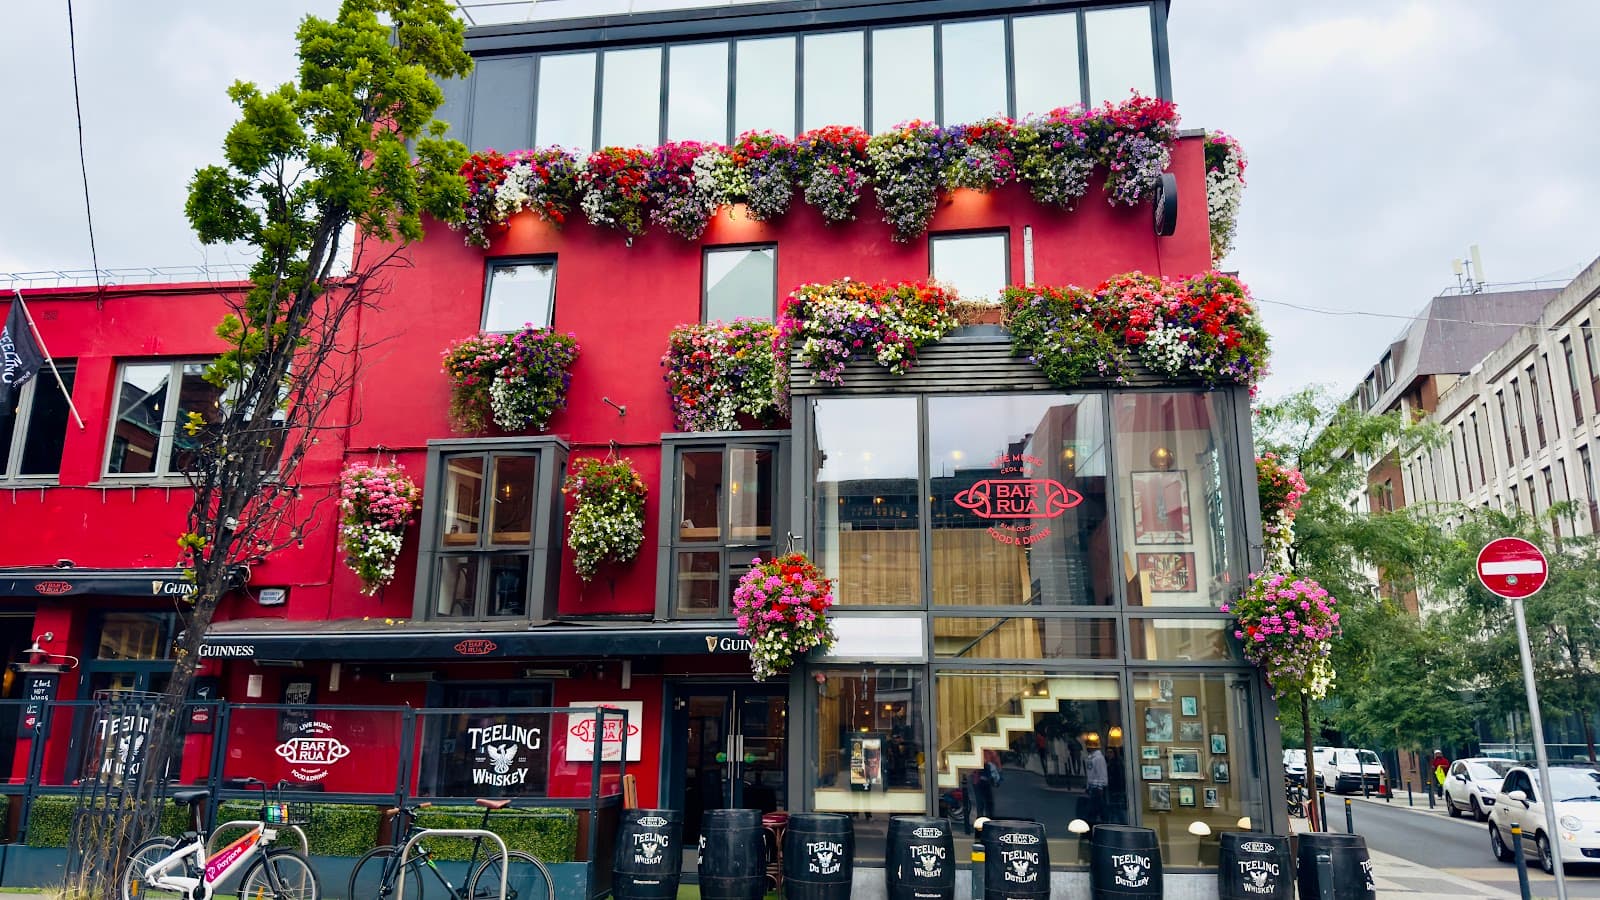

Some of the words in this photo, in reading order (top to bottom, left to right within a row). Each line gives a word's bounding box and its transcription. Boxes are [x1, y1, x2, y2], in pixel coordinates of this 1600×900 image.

[988, 454, 1010, 468] LIVE
[996, 484, 1039, 498] BAR
[996, 499, 1040, 513] RUA
[986, 526, 1014, 545] FOOD
[1014, 537, 1023, 546] &
[1022, 526, 1051, 545] DRINK
[198, 644, 255, 657] GUINNESS
[299, 721, 312, 731] LIVE
[313, 721, 333, 732] MUSIC
[467, 724, 541, 750] TEELING
[300, 741, 326, 752] BAR
[299, 751, 325, 761] RUA
[472, 768, 529, 787] WHISKEY
[632, 833, 669, 847] TEELING
[806, 841, 843, 856] TEELING
[909, 845, 946, 859] TEELING
[216, 846, 242, 871] Payzone
[1001, 850, 1039, 865] TEELING
[1111, 854, 1151, 869] TEELING
[1237, 860, 1280, 876] TEELING
[1115, 875, 1149, 888] DISTILLERY
